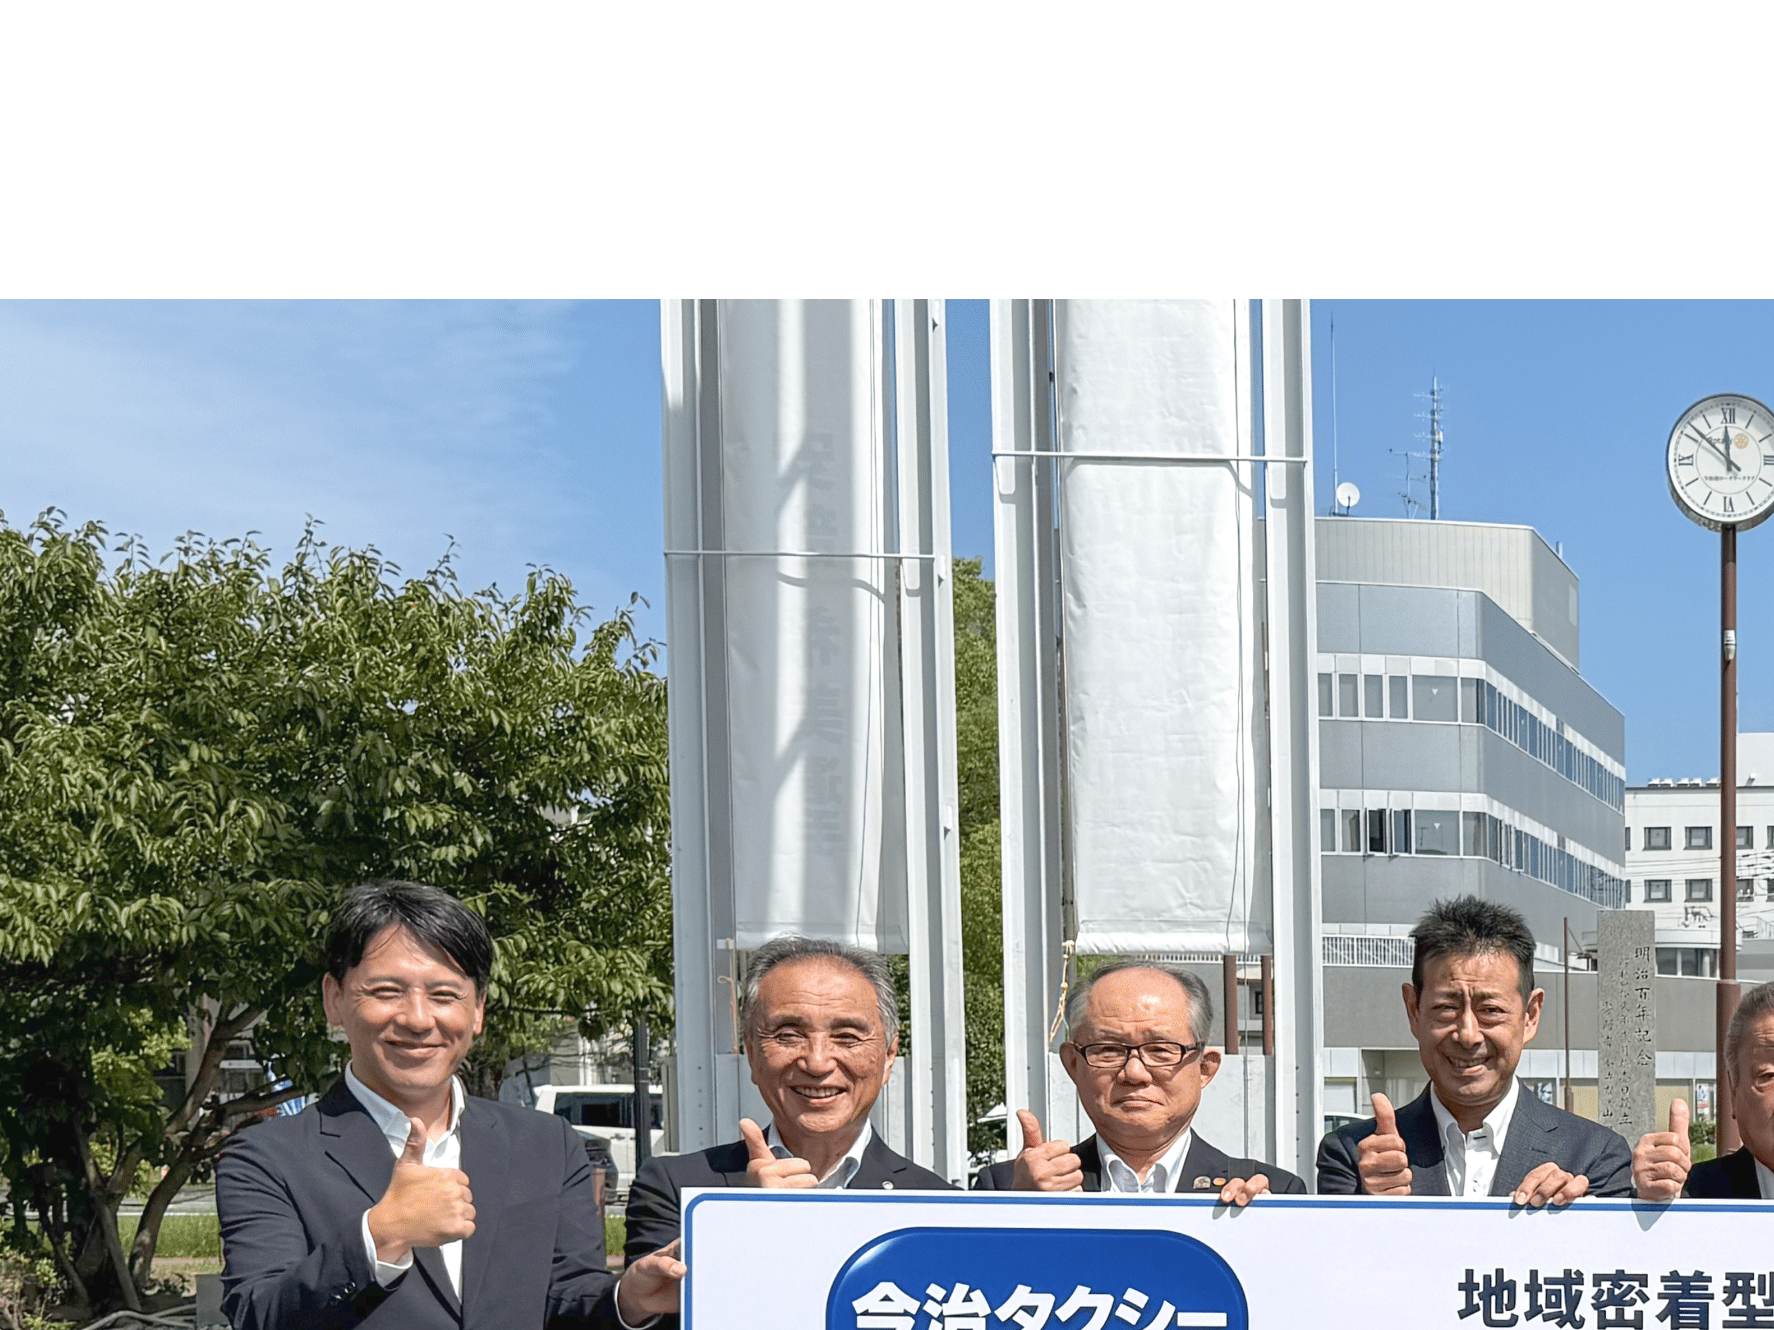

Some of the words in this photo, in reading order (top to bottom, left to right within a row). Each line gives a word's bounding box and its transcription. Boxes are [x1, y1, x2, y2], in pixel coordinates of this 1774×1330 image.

[1720, 407, 1736, 424] XII
[1706, 436, 1733, 446] Rotay
[1634, 946, 1653, 1067] 明治百年記念
